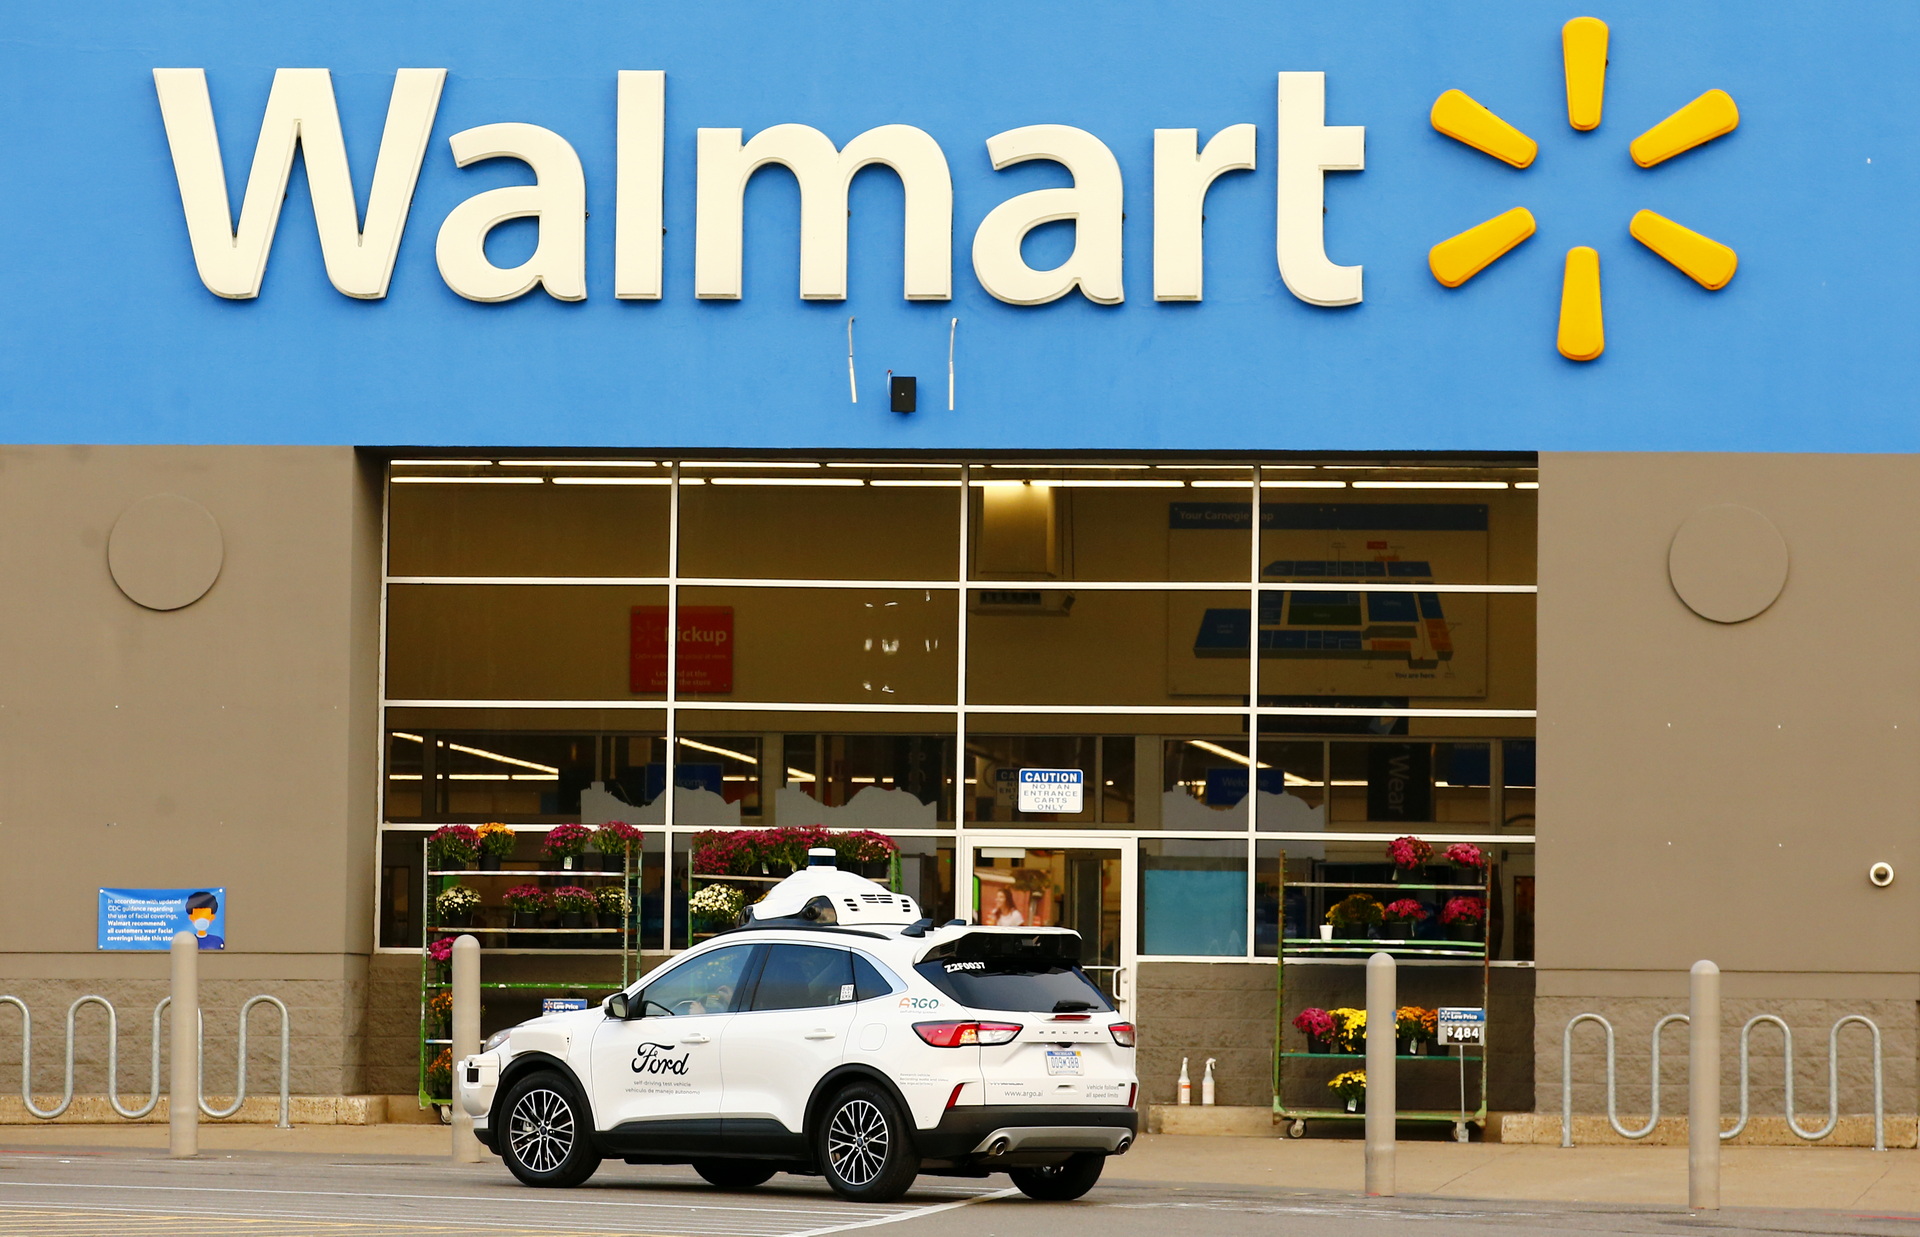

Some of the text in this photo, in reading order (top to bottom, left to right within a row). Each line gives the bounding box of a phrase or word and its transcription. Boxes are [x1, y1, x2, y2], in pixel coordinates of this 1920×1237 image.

[152, 67, 1365, 308] Walmart
[1180, 511, 1202, 520] Your
[1204, 511, 1250, 522] Carnegie
[665, 626, 727, 647] ickup
[1025, 772, 1077, 782] CAUTION
[1387, 754, 1410, 814] Wear
[944, 962, 986, 973] Z2F0037
[899, 997, 939, 1009] ARGO
[631, 1042, 690, 1075] Ford
[1004, 1090, 1044, 1098] www.argo.ai
